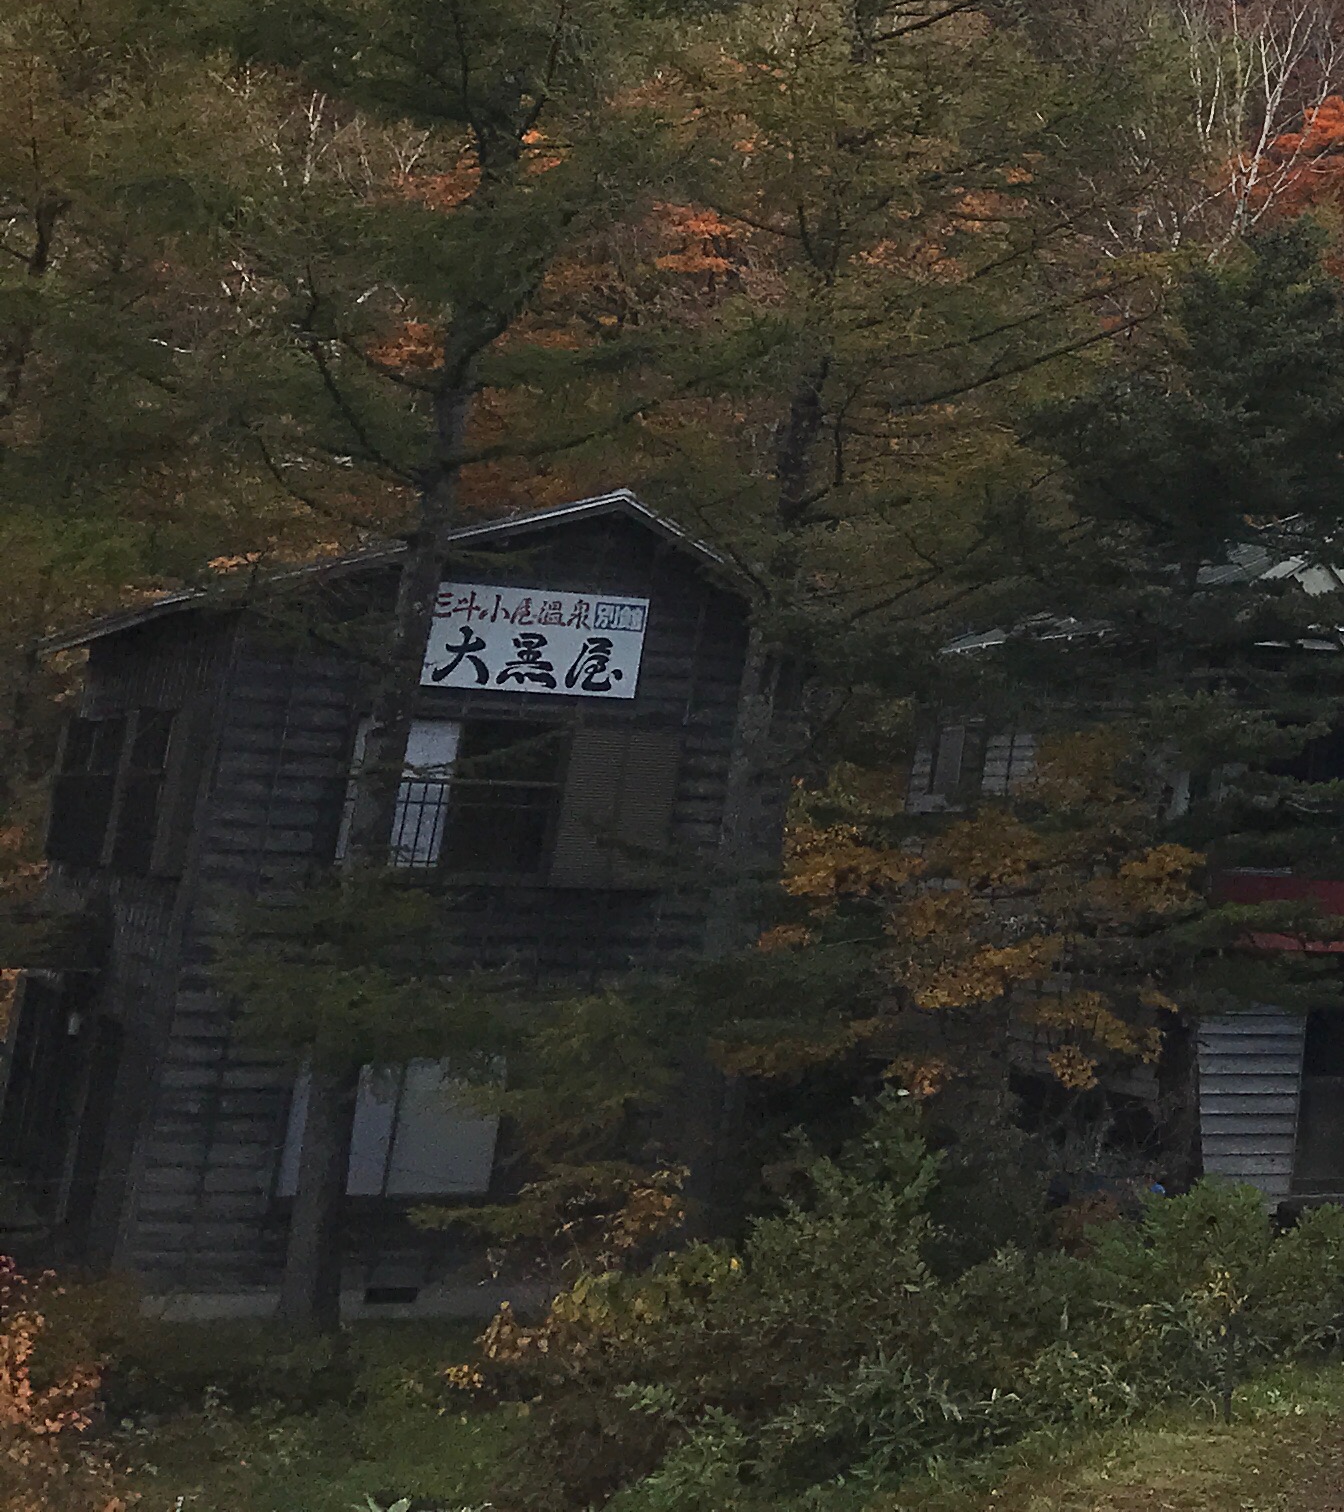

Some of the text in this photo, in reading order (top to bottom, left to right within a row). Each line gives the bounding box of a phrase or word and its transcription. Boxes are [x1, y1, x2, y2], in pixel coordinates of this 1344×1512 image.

[432, 590, 592, 631] 三斗小屋温泉
[431, 624, 624, 692] 大黒屋
